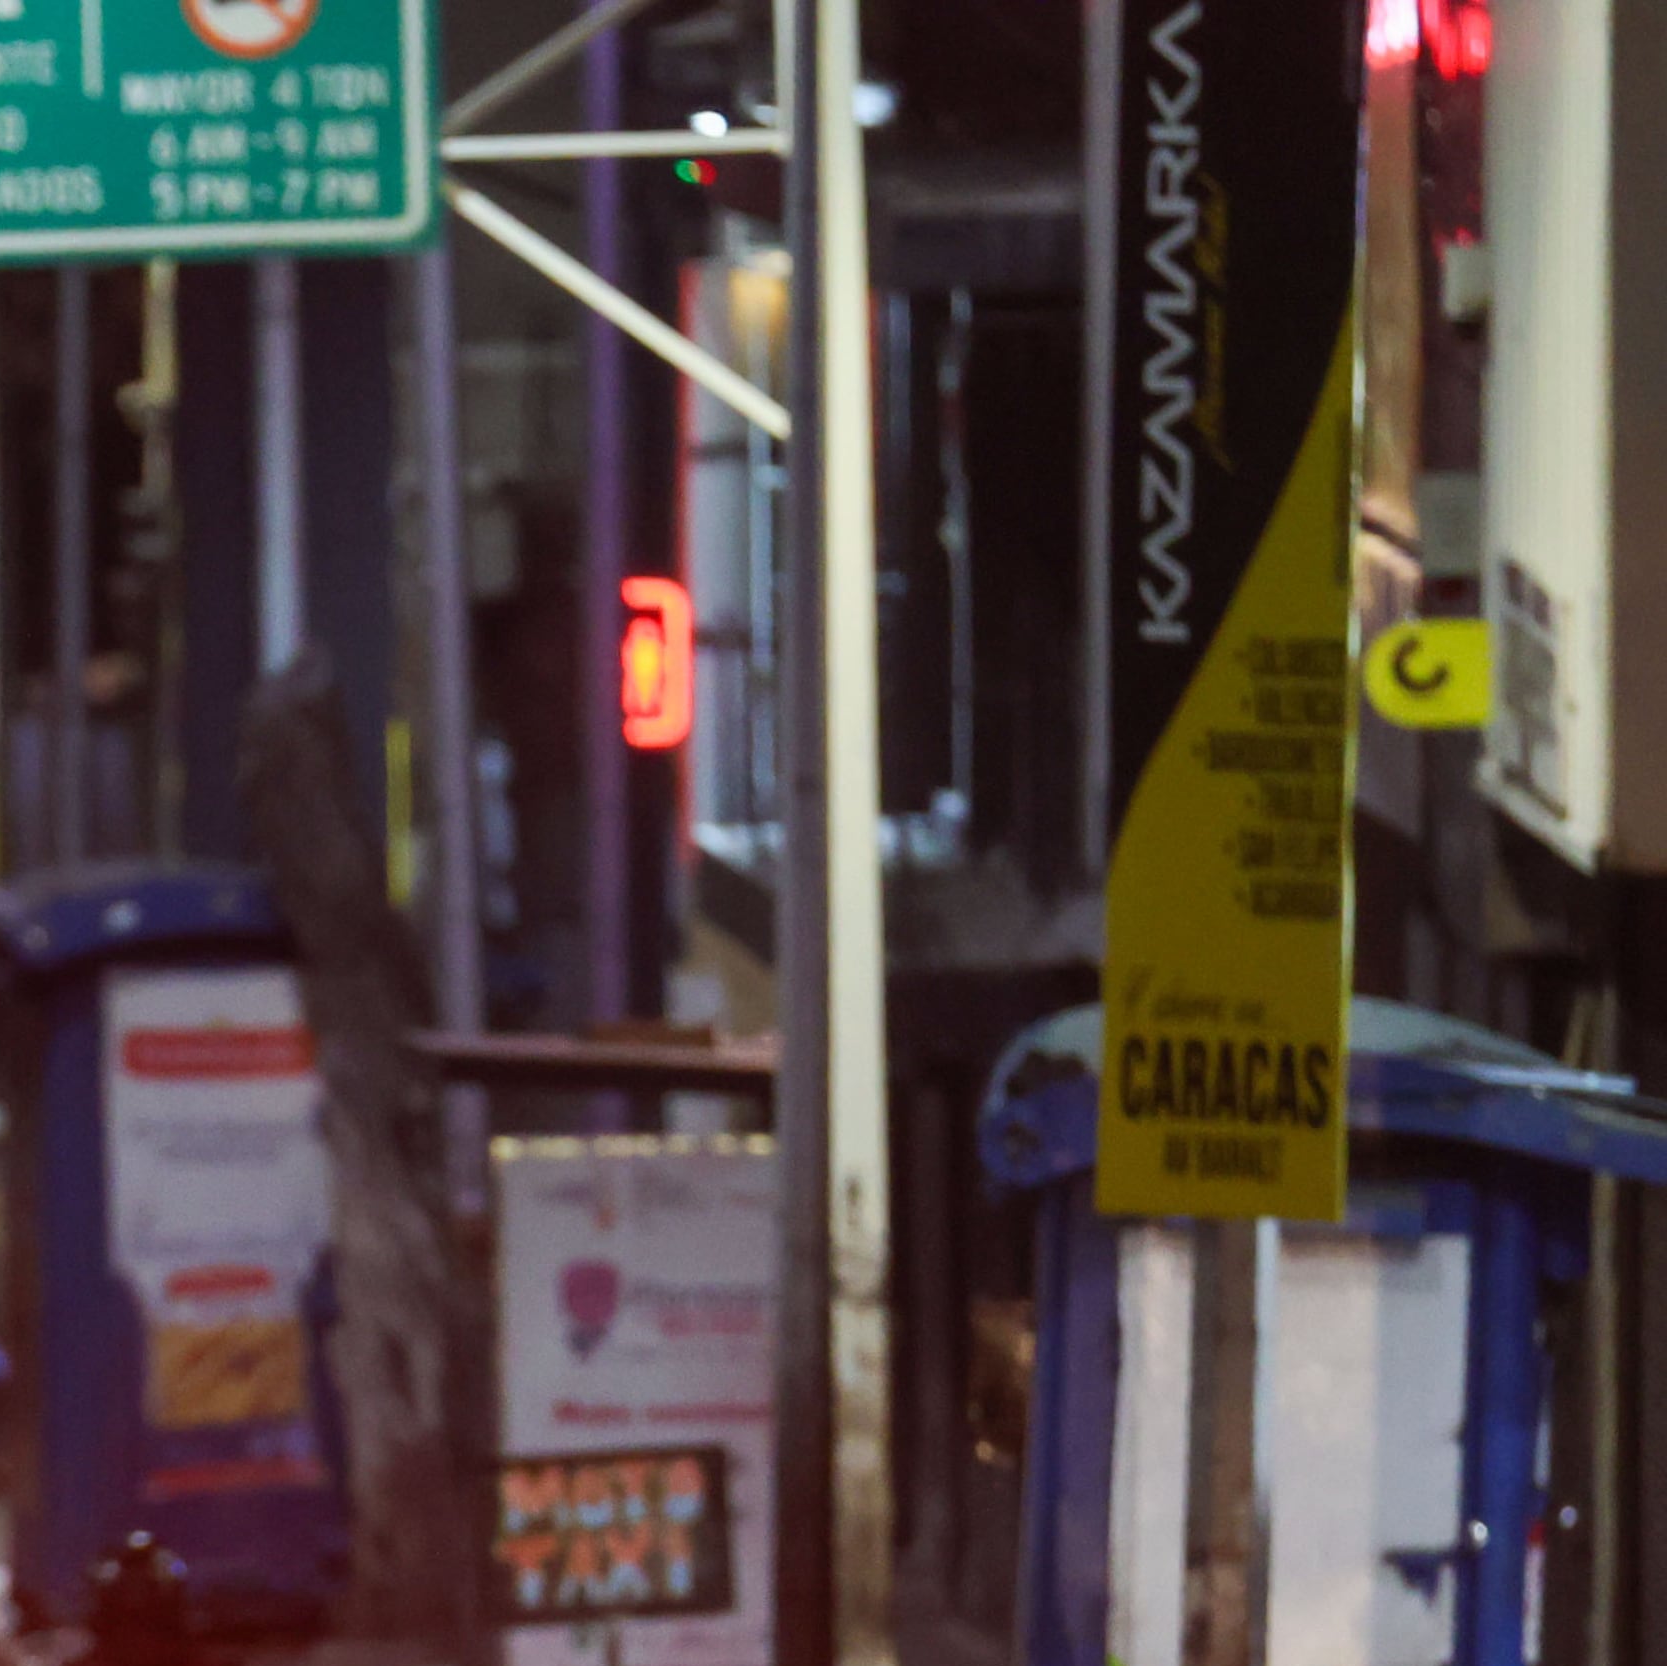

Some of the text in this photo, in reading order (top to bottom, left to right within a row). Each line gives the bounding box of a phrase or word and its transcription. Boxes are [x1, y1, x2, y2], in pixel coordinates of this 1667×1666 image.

[120, 68, 255, 115] MAYOR
[1137, 0, 1204, 643] KAZAMARKA
[1121, 1033, 1330, 1129] CARACAS
[501, 1455, 705, 1531] MOTO
[494, 1523, 695, 1608] TAXI
